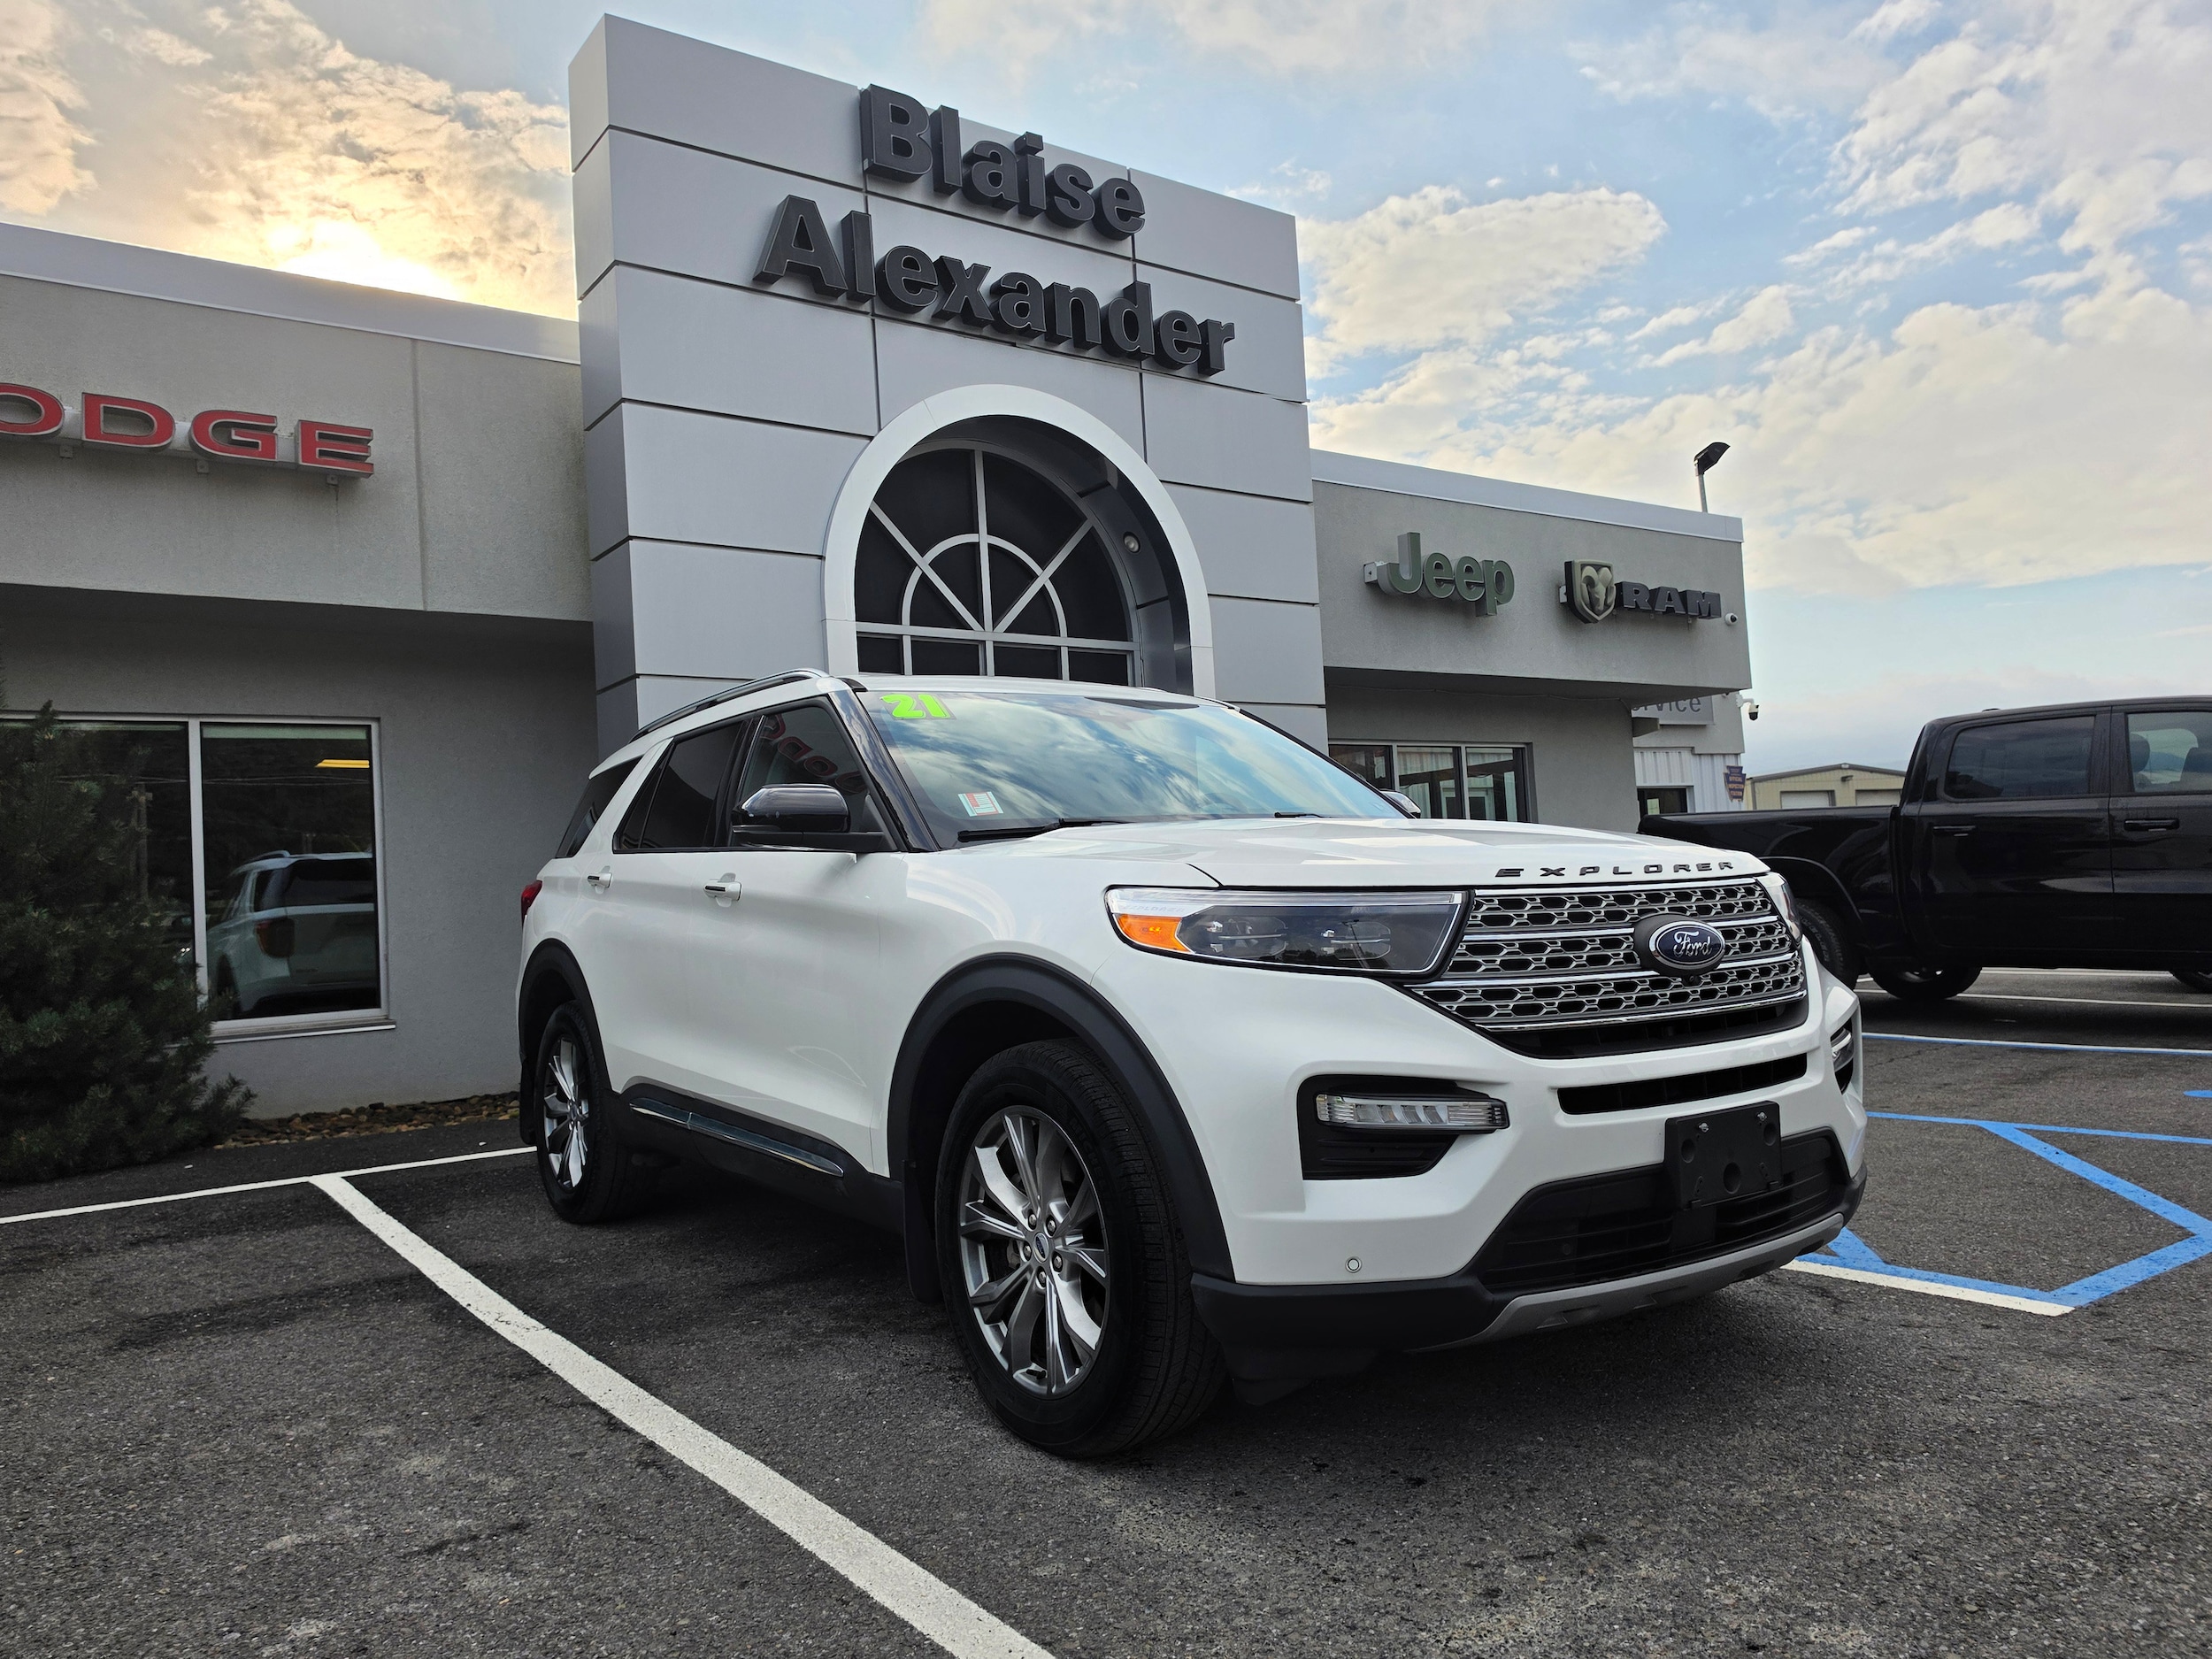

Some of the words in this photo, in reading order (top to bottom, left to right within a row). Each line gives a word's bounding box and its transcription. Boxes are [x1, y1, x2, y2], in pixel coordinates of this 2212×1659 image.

[859, 83, 1146, 241] Blaise
[752, 194, 1235, 376] Alexander
[1377, 532, 1515, 617] Jeep
[1615, 580, 1722, 619] RAM
[879, 694, 950, 719] 21
[1494, 862, 1734, 878] EXPLORER
[1673, 931, 1712, 956] Ford
